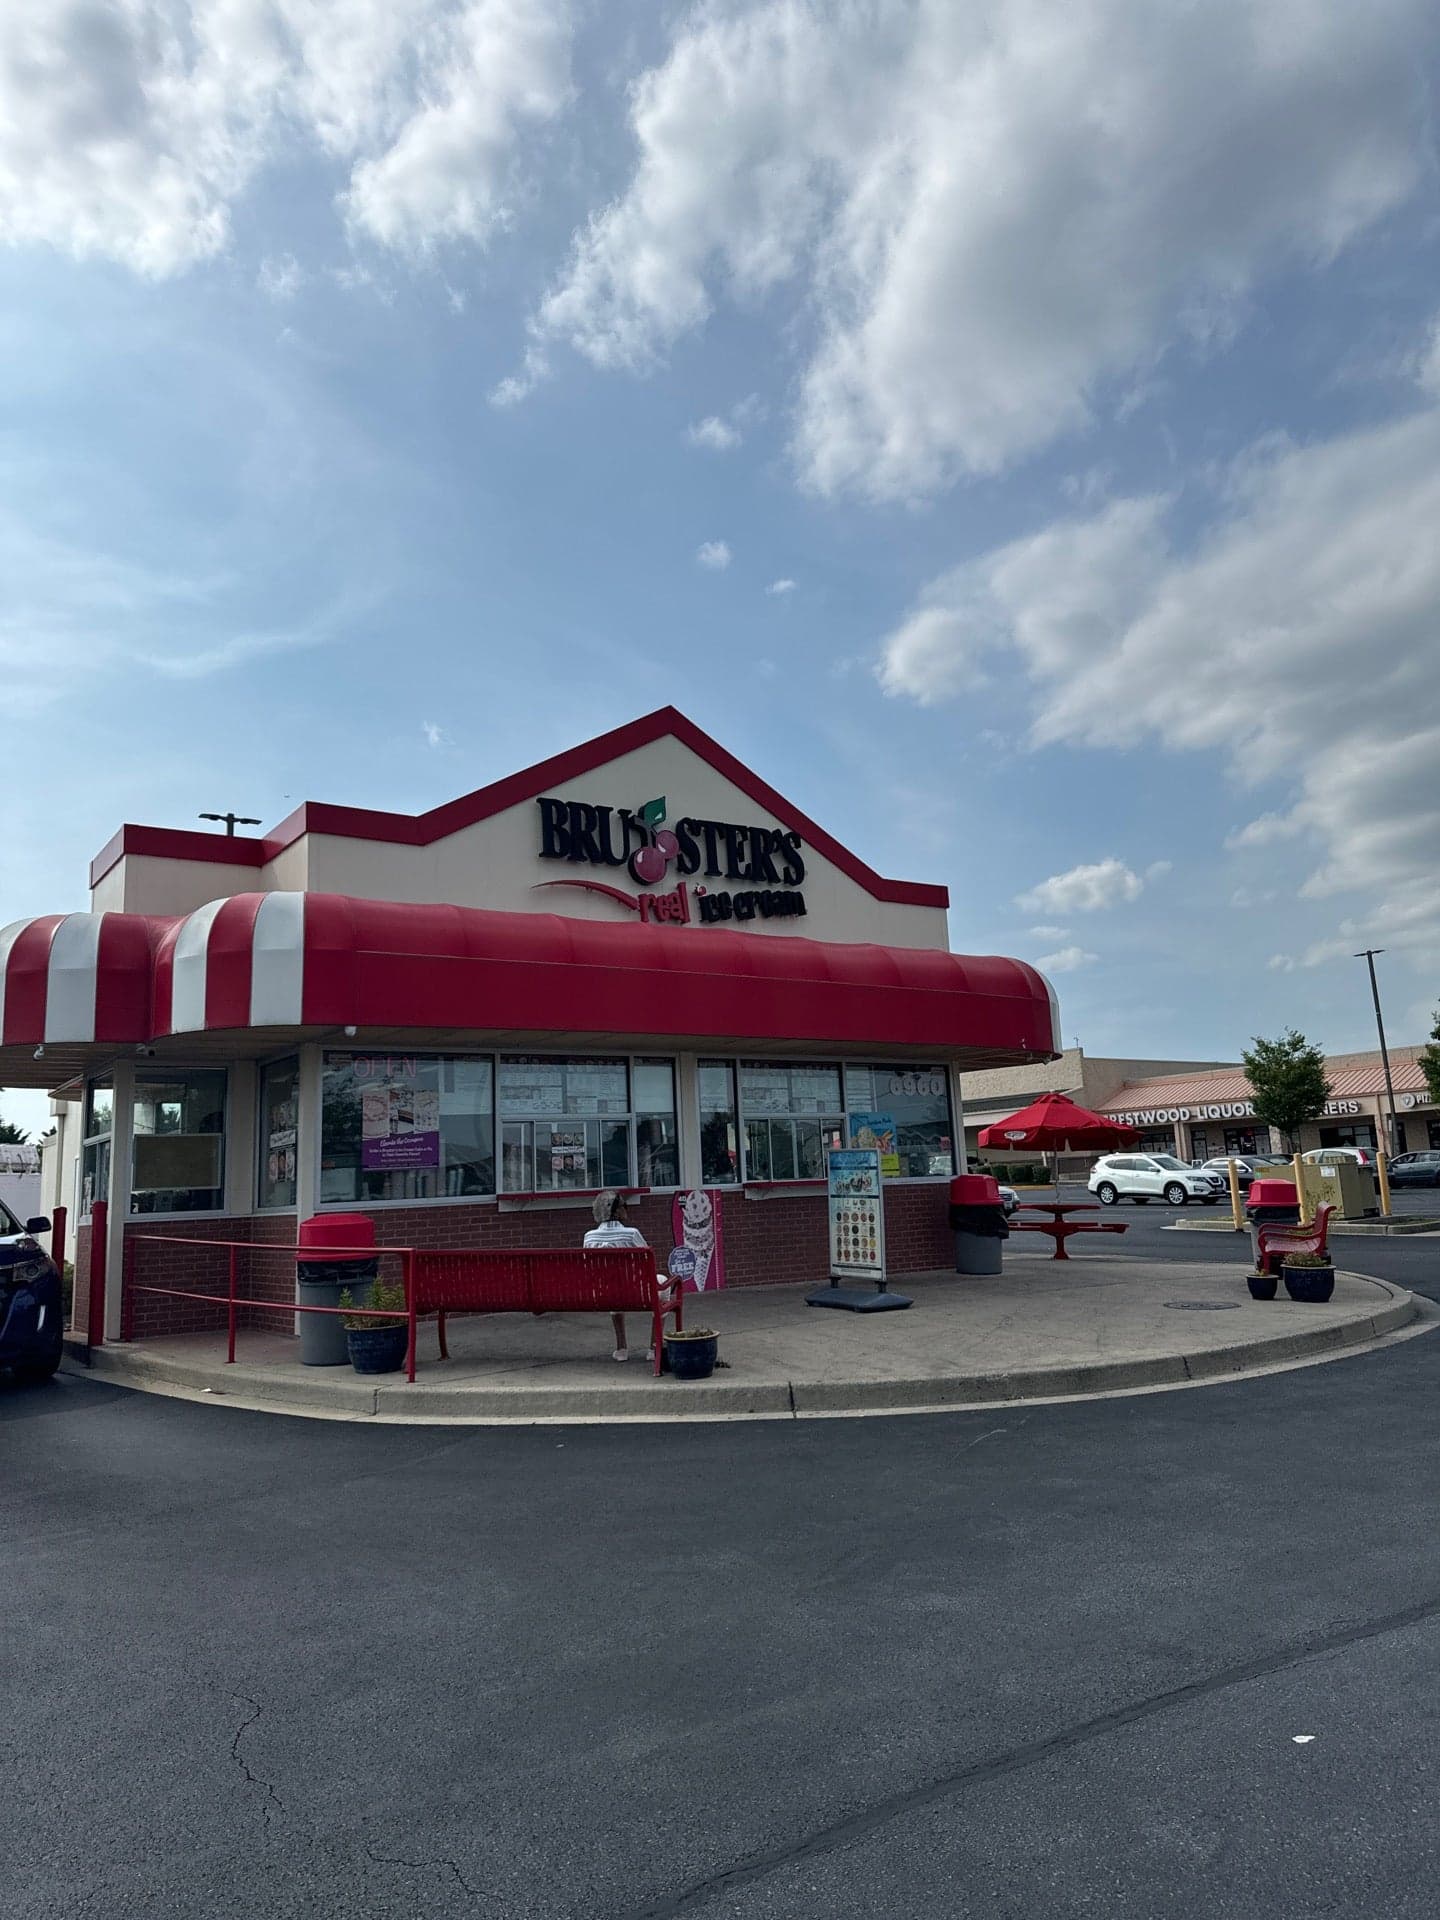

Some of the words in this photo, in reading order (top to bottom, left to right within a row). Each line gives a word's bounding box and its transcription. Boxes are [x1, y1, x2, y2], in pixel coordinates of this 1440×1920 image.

[536, 797, 805, 886] BRUSTER'S
[638, 882, 691, 923] real
[695, 884, 733, 923] ice
[733, 889, 807, 920] cream
[1104, 1107, 1190, 1127] RESTWOOD
[1196, 1102, 1257, 1119] LIQUOR
[671, 1262, 695, 1274] FREE
